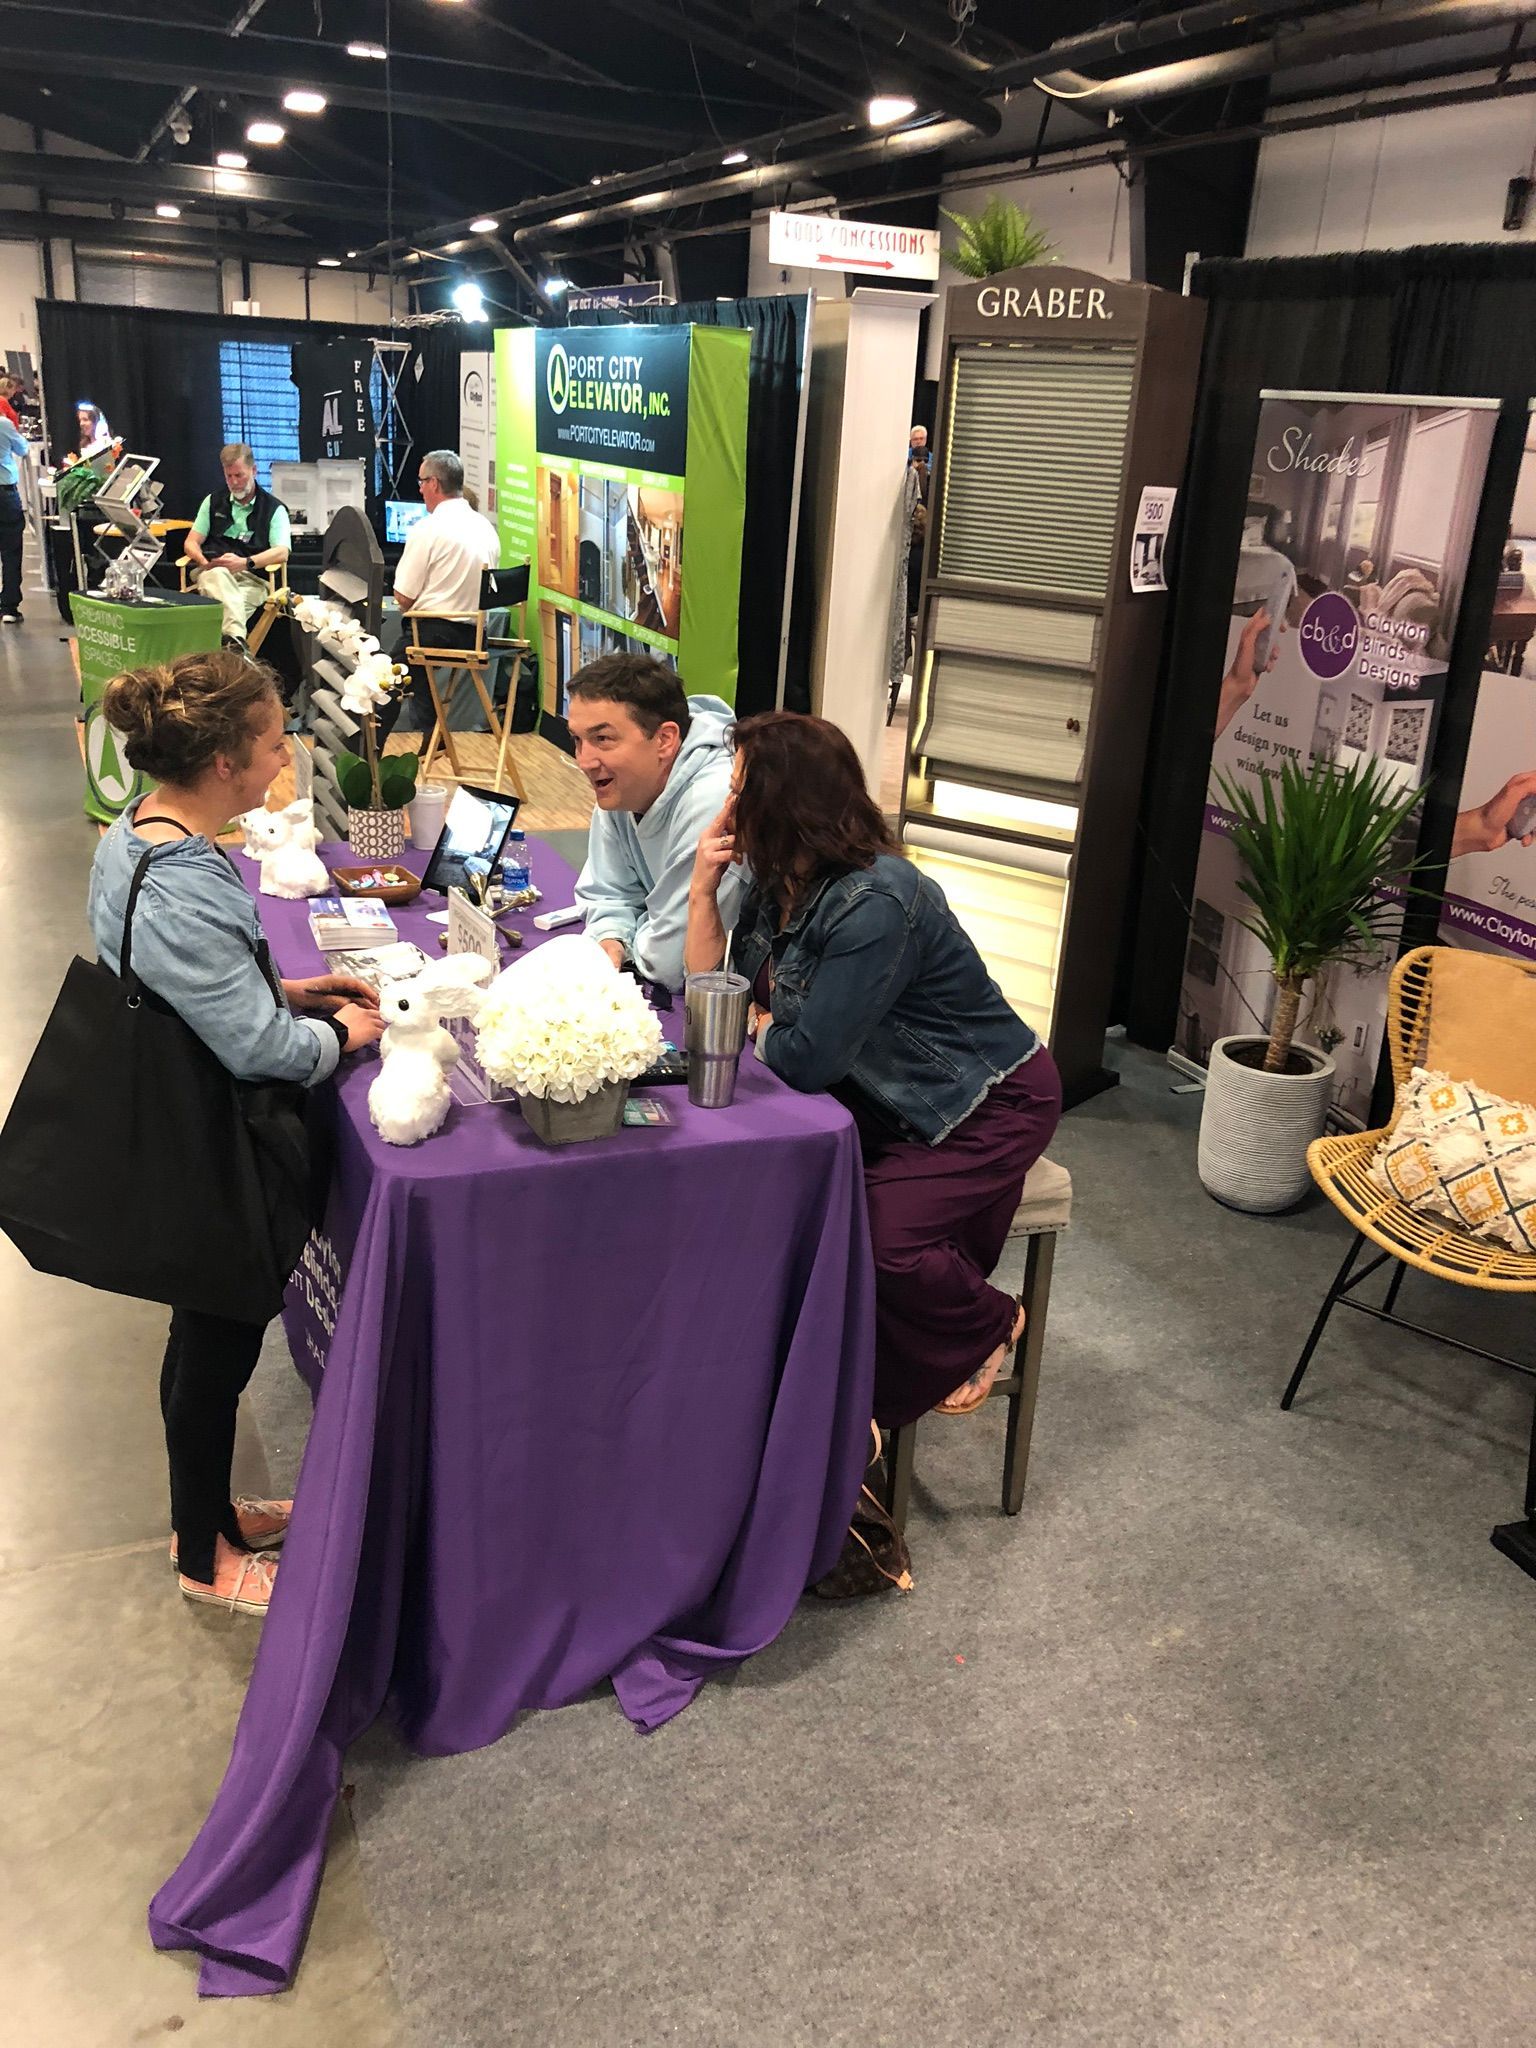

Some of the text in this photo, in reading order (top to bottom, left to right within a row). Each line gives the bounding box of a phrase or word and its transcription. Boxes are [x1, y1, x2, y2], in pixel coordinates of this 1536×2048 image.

[784, 219, 823, 243] FOOD
[569, 355, 643, 381] PORT CITY
[569, 380, 671, 421] ELEVATOR, INC.
[1266, 426, 1377, 477] Shades
[1301, 616, 1358, 655] cb&d
[1366, 613, 1428, 641] Clayton
[1362, 636, 1405, 661] Blinds
[1359, 658, 1421, 688] Designs
[1253, 704, 1289, 728] Let us
[1234, 725, 1302, 760] design your
[1487, 875, 1517, 902] The
